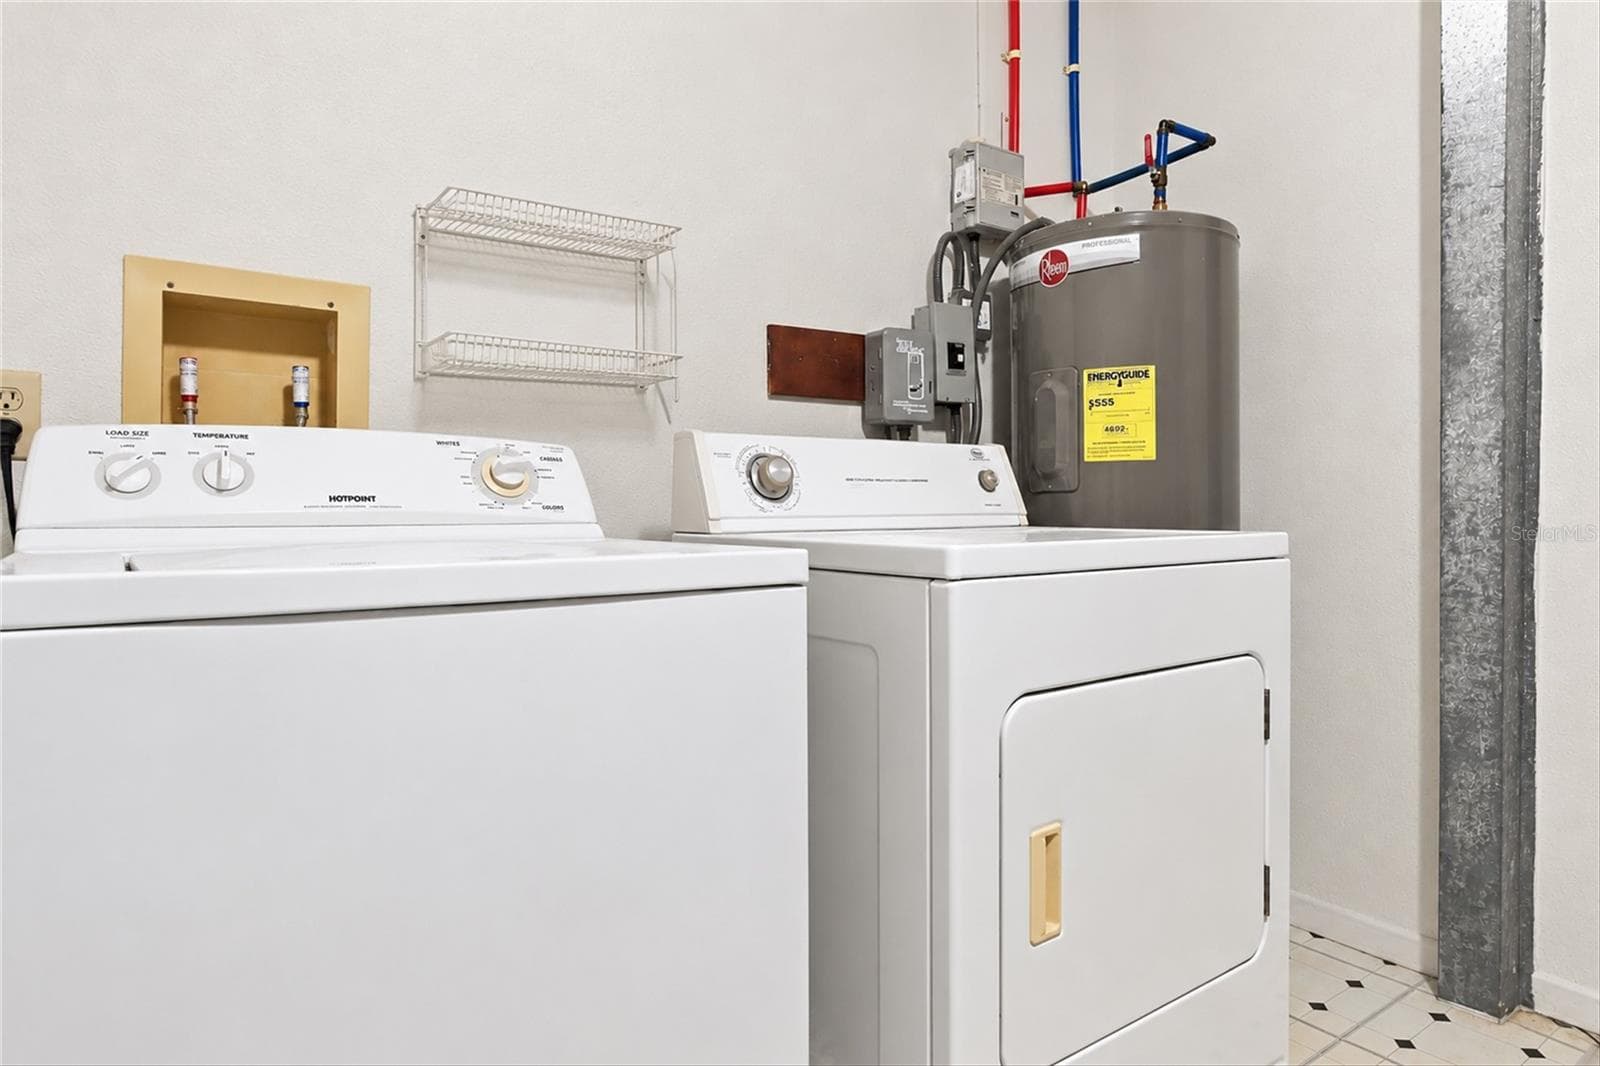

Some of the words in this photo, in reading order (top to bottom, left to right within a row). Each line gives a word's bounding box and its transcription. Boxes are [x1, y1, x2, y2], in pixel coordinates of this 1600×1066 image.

[1041, 251, 1067, 281] Rheem
[1087, 369, 1150, 387] ENERGYGUIDE
[193, 432, 249, 440] TEMPERATURE
[328, 495, 376, 503] HOTPOINT
